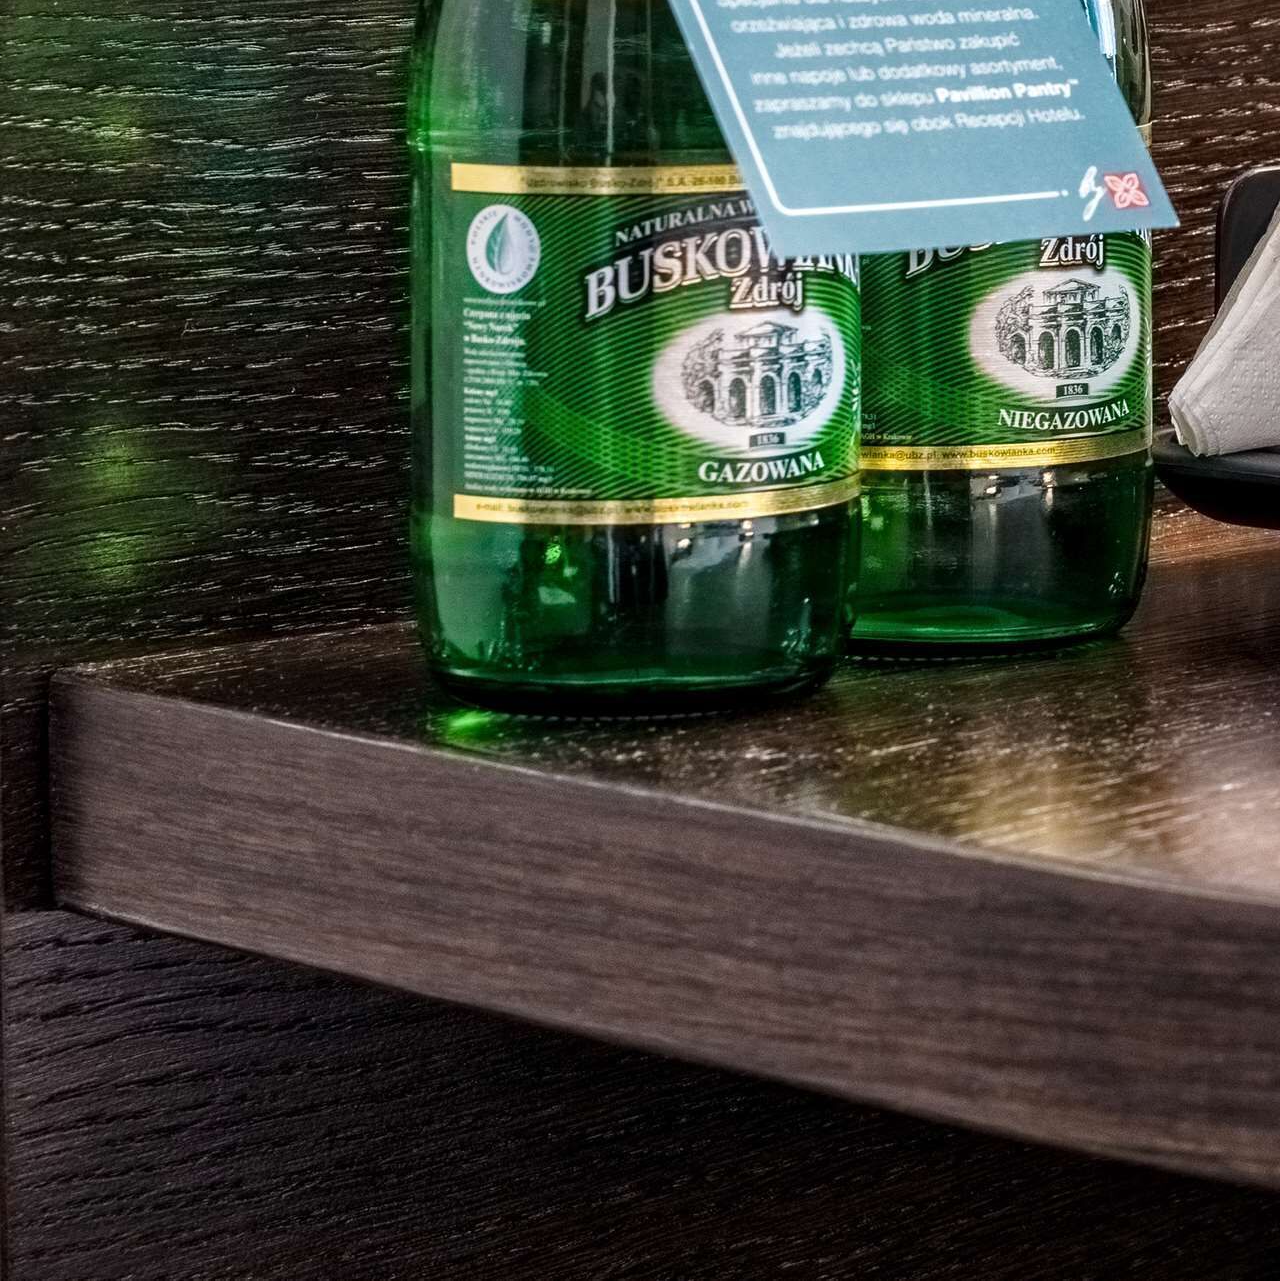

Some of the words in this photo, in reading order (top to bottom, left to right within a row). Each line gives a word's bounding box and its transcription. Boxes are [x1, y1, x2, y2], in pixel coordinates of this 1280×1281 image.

[849, 13, 908, 29] zdrowa
[908, 9, 955, 25] woda
[883, 35, 956, 54] Państwo
[957, 30, 1021, 51] zakupić
[751, 71, 788, 85] inne
[788, 69, 848, 86] napoje
[848, 65, 876, 81] lub
[876, 62, 967, 81] dodatkowy
[753, 94, 851, 113] zapraszamy
[853, 92, 879, 108] do
[879, 89, 936, 108] sklepu
[771, 122, 883, 141] znajdującego
[882, 117, 910, 135] się
[910, 116, 954, 132] obok
[953, 110, 1026, 129] Recepcji
[615, 202, 735, 247] NATURALNA
[1039, 233, 1104, 269] Zdrój
[729, 272, 803, 312] Zdrój
[1063, 383, 1083, 396] 1836
[996, 399, 1131, 431] NIEGAZOWANA
[698, 450, 825, 483] GAZOWANA
